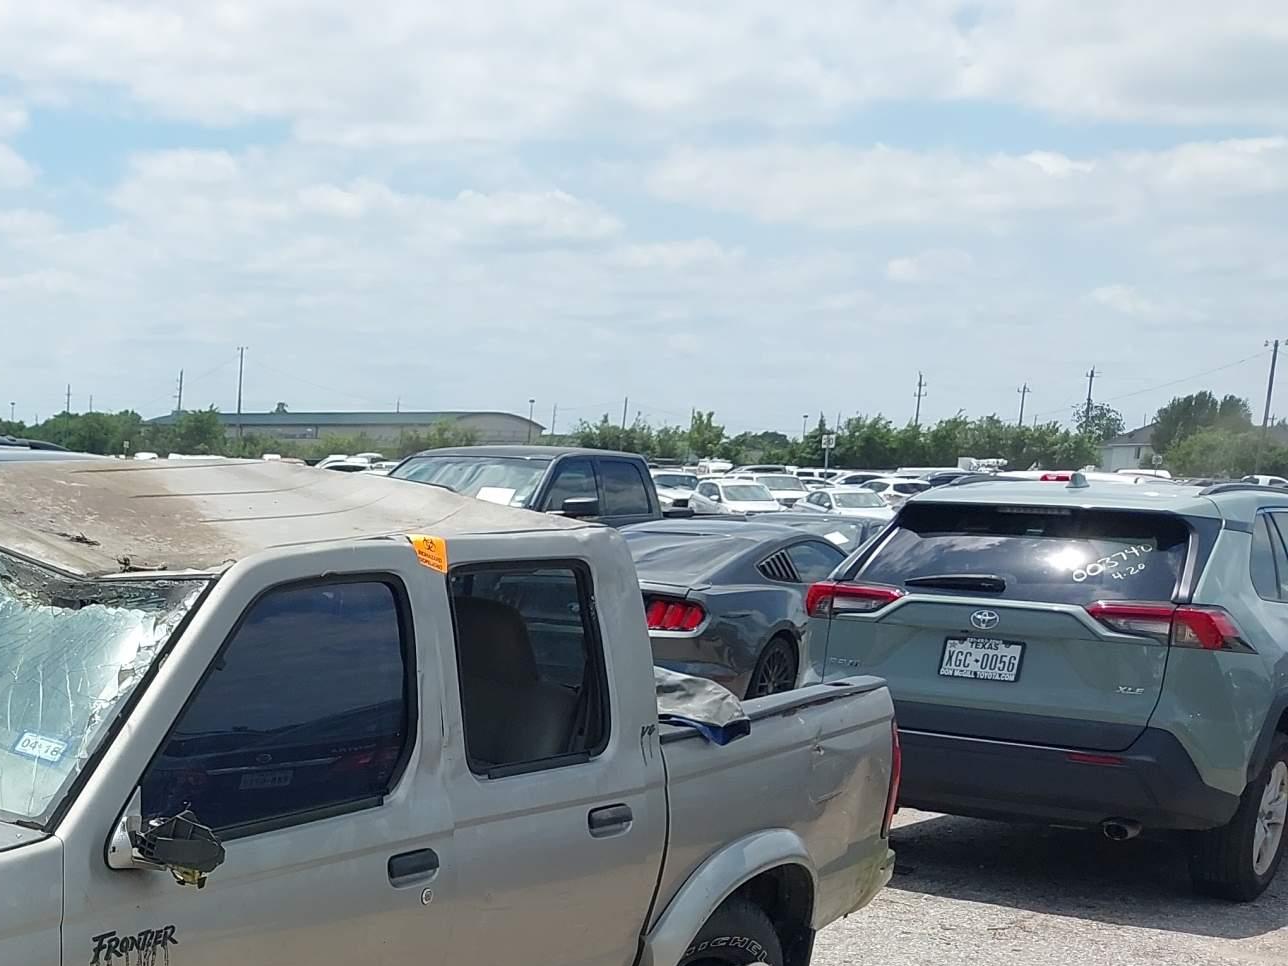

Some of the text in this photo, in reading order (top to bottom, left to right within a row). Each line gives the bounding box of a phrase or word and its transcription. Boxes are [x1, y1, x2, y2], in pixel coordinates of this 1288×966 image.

[1072, 544, 1153, 582] 003740
[1112, 563, 1146, 579] 4.20
[968, 641, 999, 651] TEXAS
